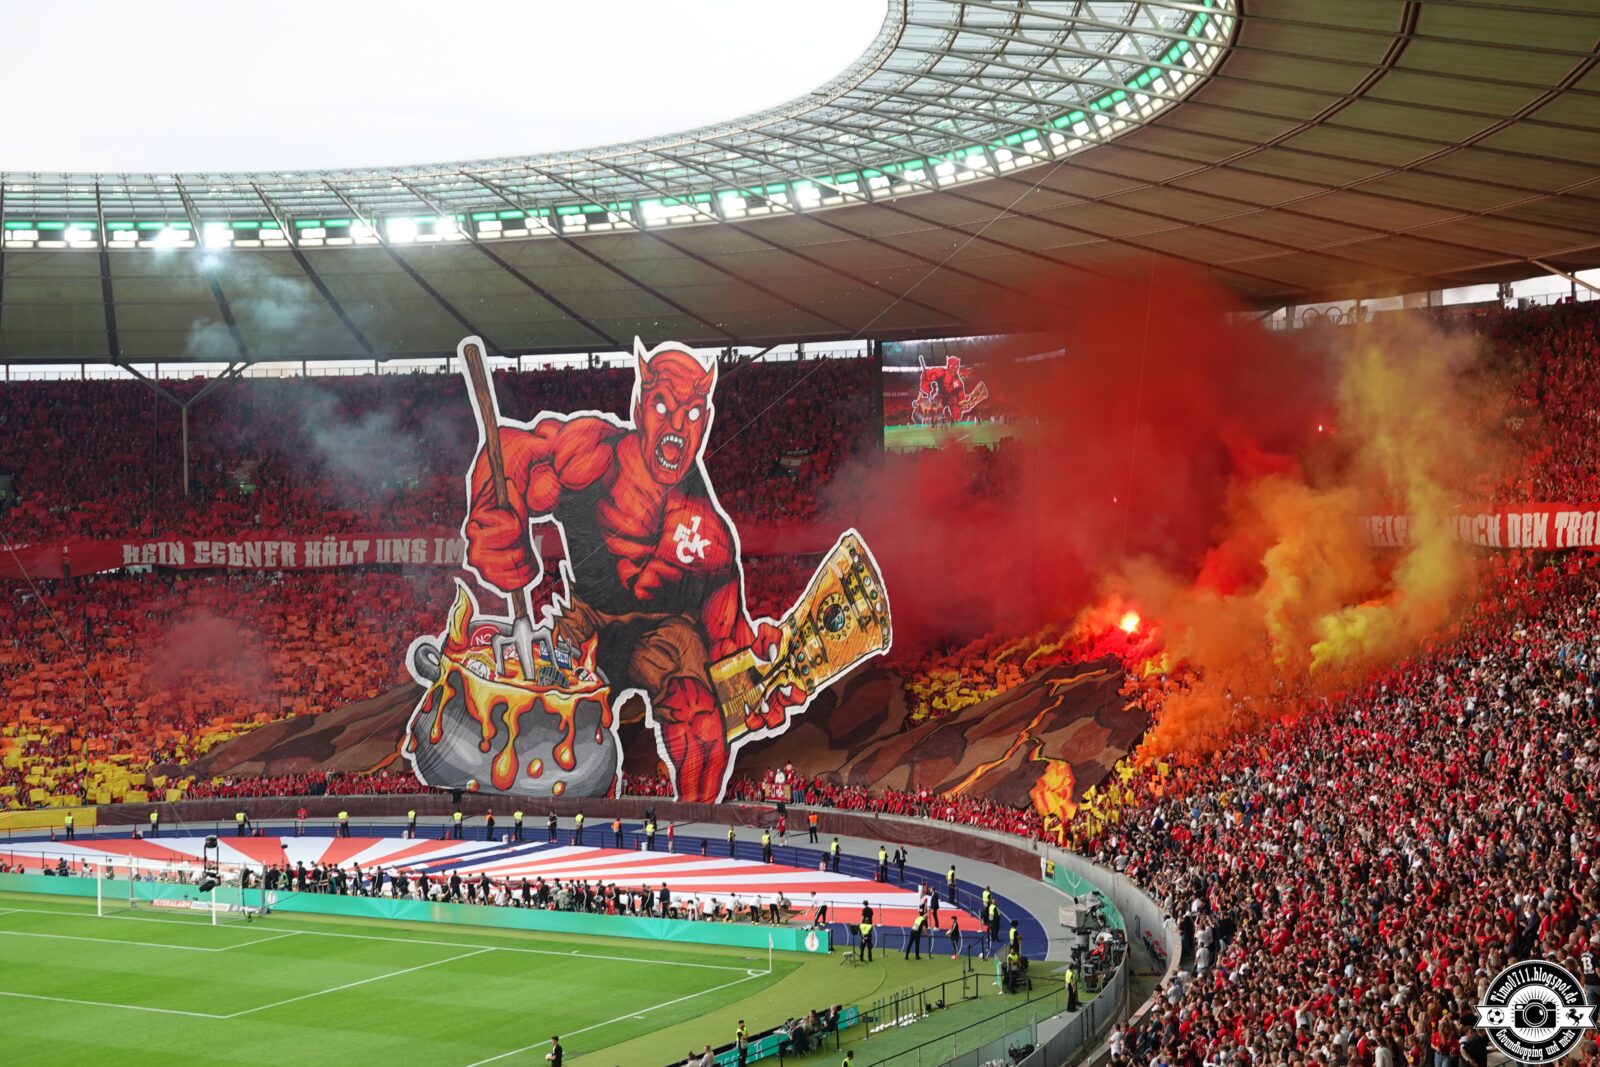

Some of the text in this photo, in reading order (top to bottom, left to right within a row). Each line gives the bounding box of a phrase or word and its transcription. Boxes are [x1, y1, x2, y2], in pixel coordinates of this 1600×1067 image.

[122, 536, 465, 567] KEIN GEGNER HÄLT UNS IM
